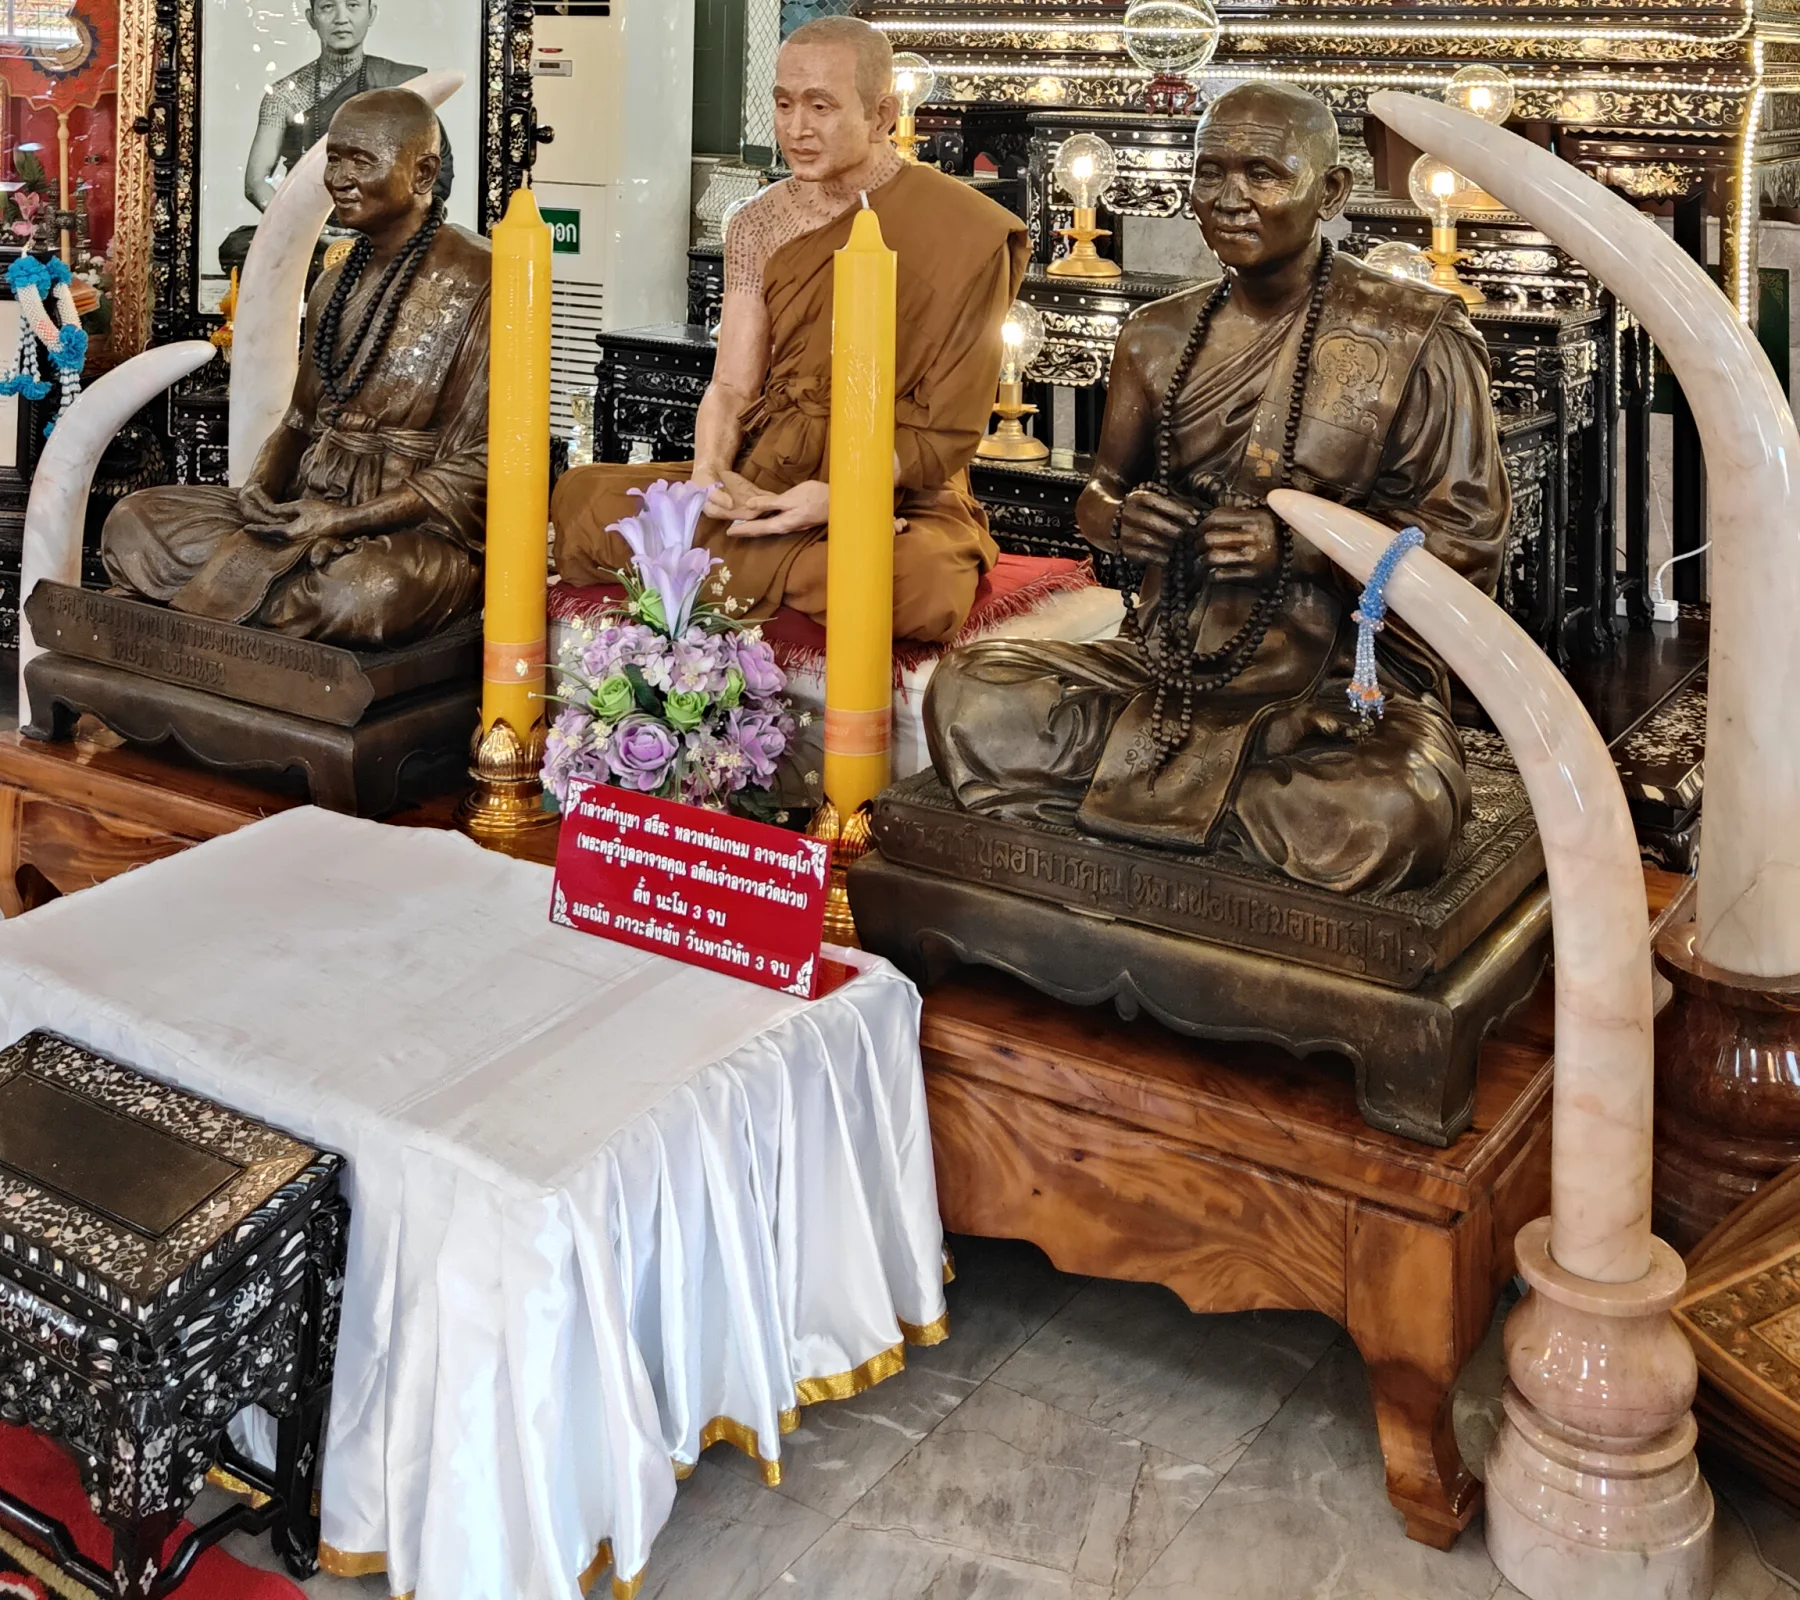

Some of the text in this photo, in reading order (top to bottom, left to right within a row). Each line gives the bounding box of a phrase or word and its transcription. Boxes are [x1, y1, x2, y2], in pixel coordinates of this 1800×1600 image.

[579, 796, 640, 835] กล่าวคำบูชา
[643, 813, 670, 838] สรีระ
[674, 825, 750, 859] หลวงพ่อเกษม
[633, 875, 727, 928] ตั้ง นะโม 3 จบ
[572, 902, 610, 926] มรณัง
[755, 955, 765, 971] 3
[770, 959, 790, 979] จบ
